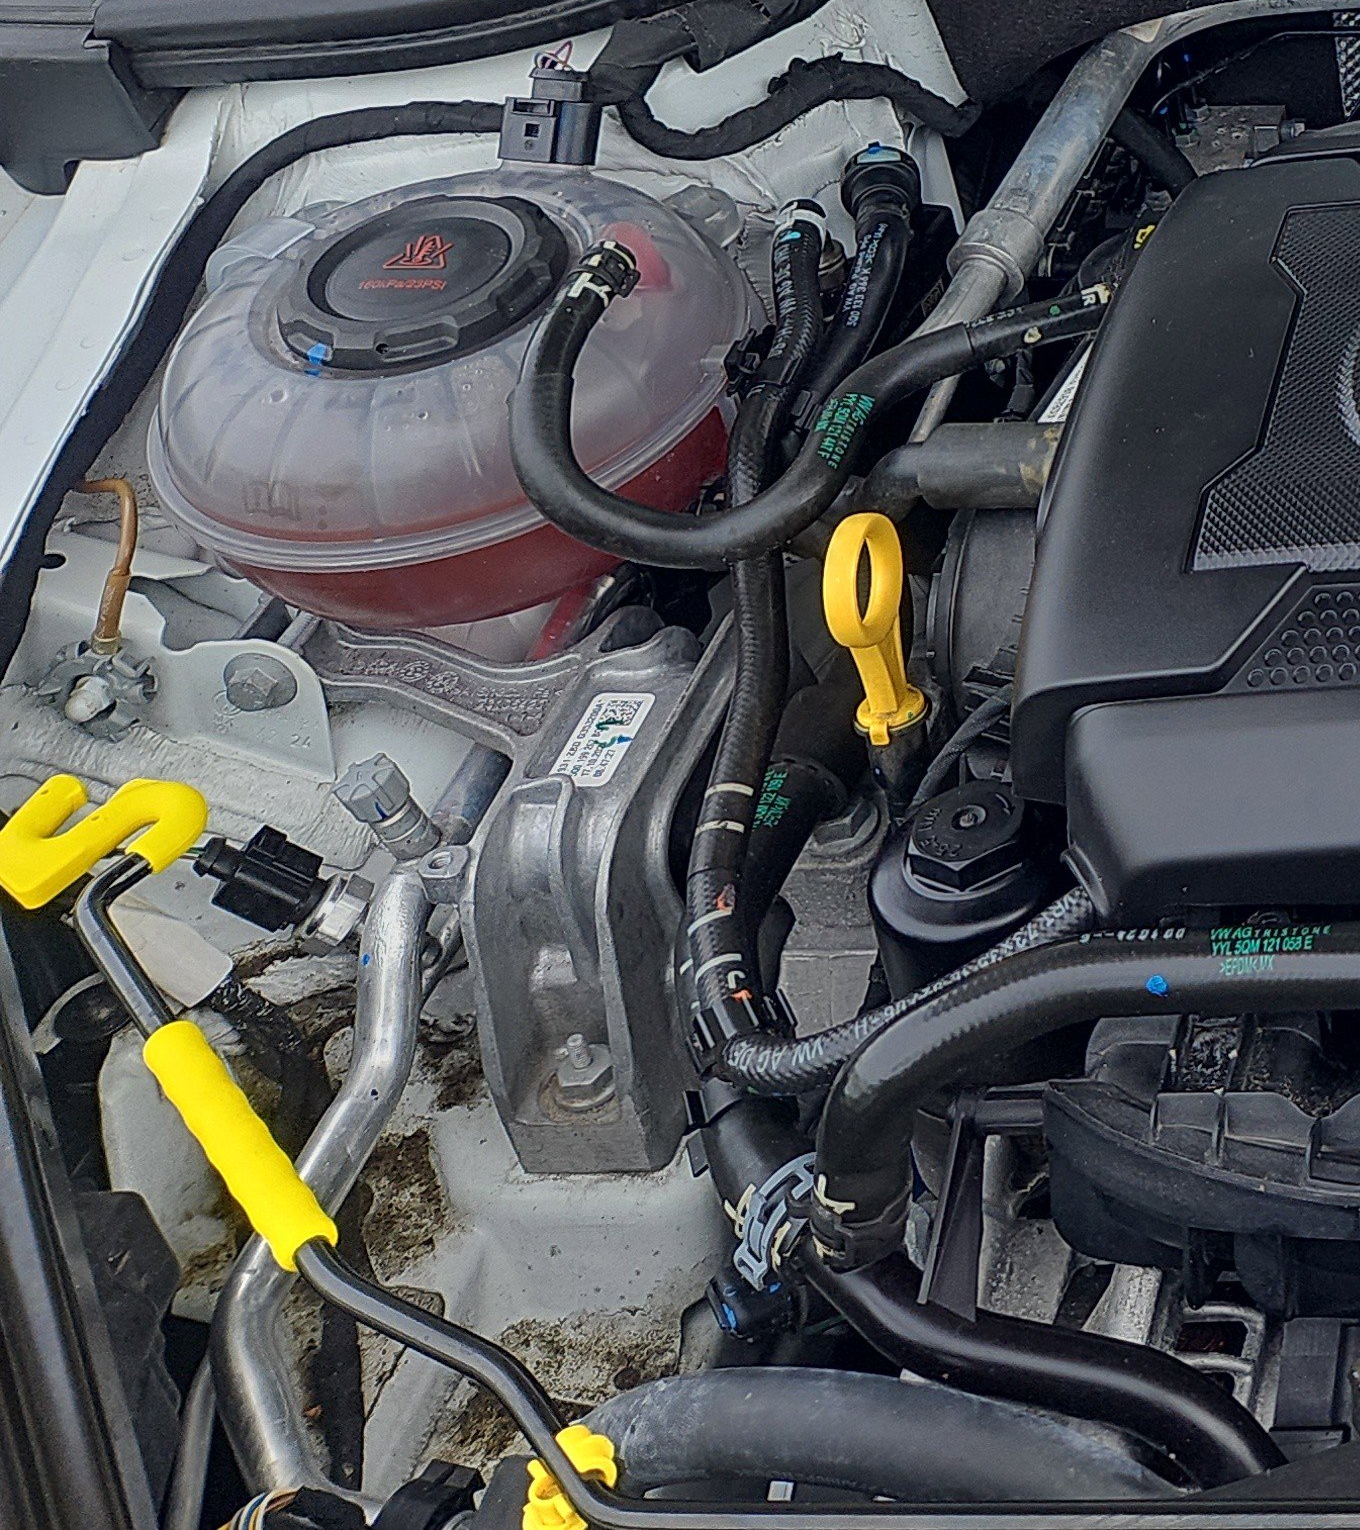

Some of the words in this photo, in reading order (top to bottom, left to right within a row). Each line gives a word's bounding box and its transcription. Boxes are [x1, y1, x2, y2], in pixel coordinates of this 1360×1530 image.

[1254, 923, 1332, 938] TRISTONE
[1262, 937, 1281, 953] 121
[1303, 934, 1313, 950] E
